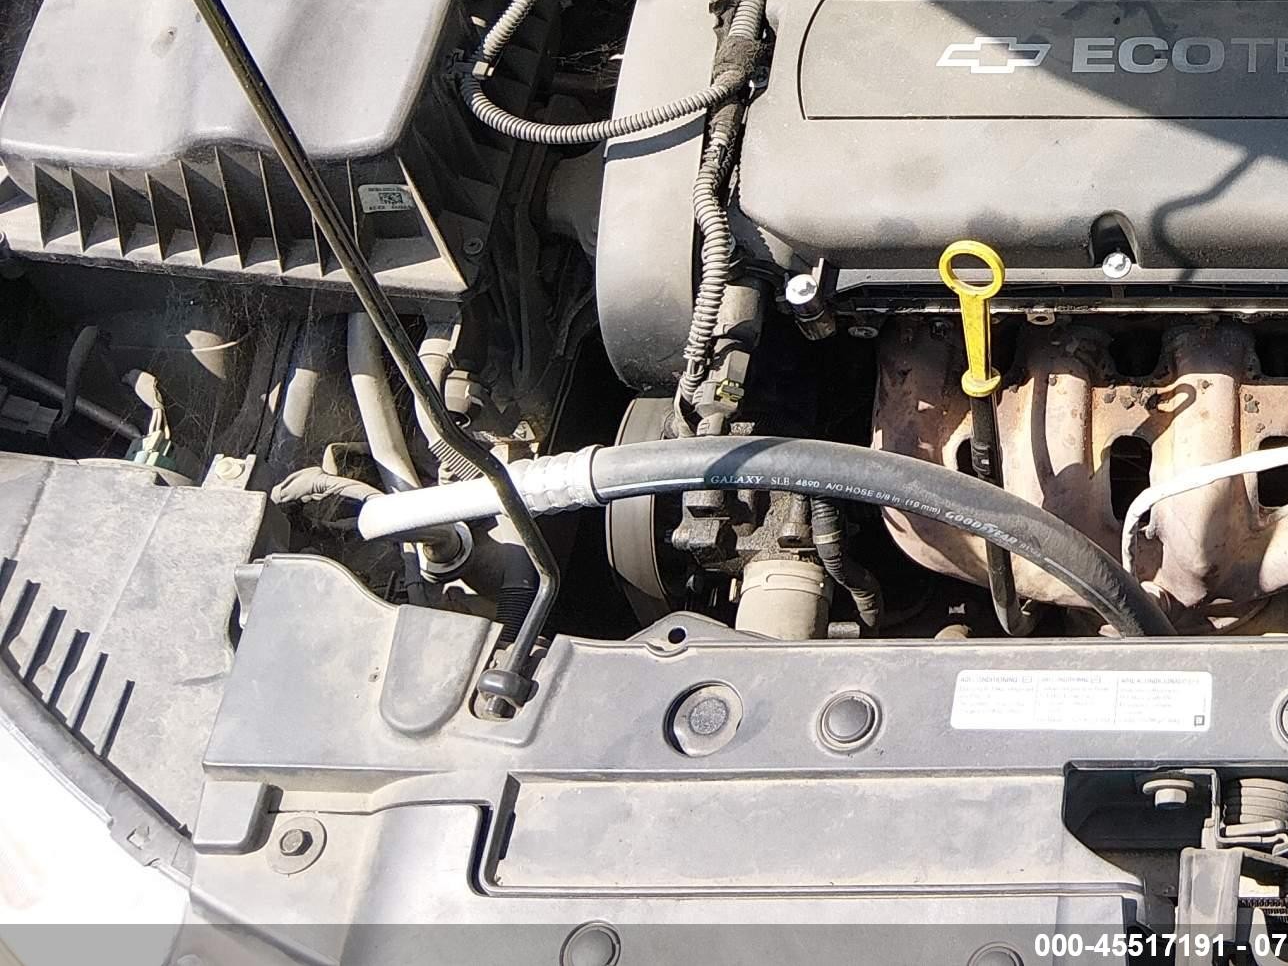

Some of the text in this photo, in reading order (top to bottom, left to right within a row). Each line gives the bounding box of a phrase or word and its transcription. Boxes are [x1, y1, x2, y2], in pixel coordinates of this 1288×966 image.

[710, 475, 765, 485] GALAXY
[825, 482, 843, 492] A/C
[845, 485, 875, 497] HOSE
[920, 503, 941, 515] mm)
[944, 510, 1020, 545] GOODYEAR
